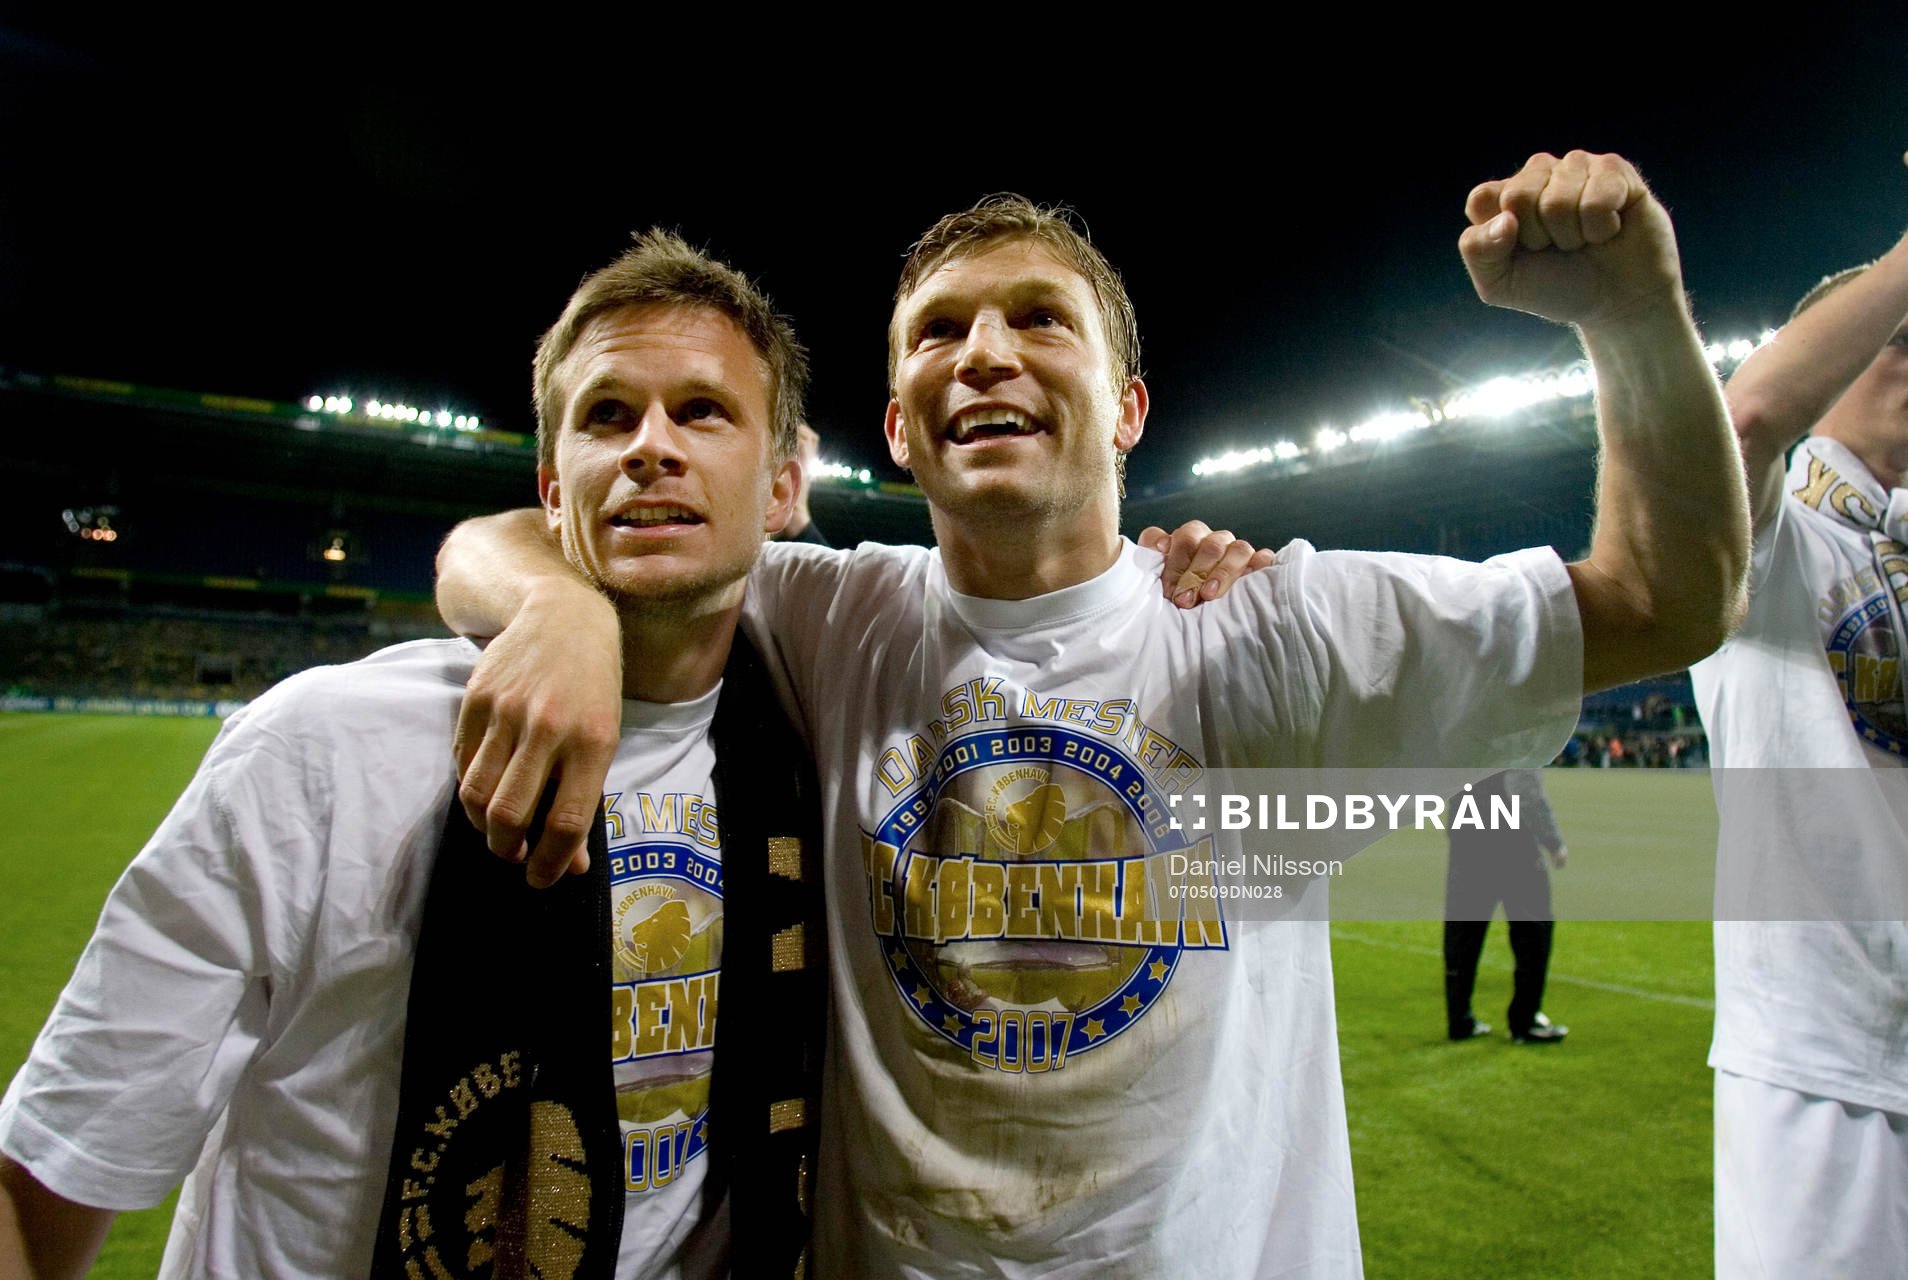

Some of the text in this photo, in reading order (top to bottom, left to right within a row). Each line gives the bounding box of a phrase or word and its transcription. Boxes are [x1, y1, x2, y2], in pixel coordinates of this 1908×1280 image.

[1020, 687, 1204, 796] MESTER
[891, 736, 1170, 839] 1997 2001 2003 2004 2006
[611, 852, 676, 876] 2003
[903, 834, 1230, 950] KØBENHAVN
[970, 1010, 1077, 1074] 2007
[621, 1119, 696, 1193] 007
